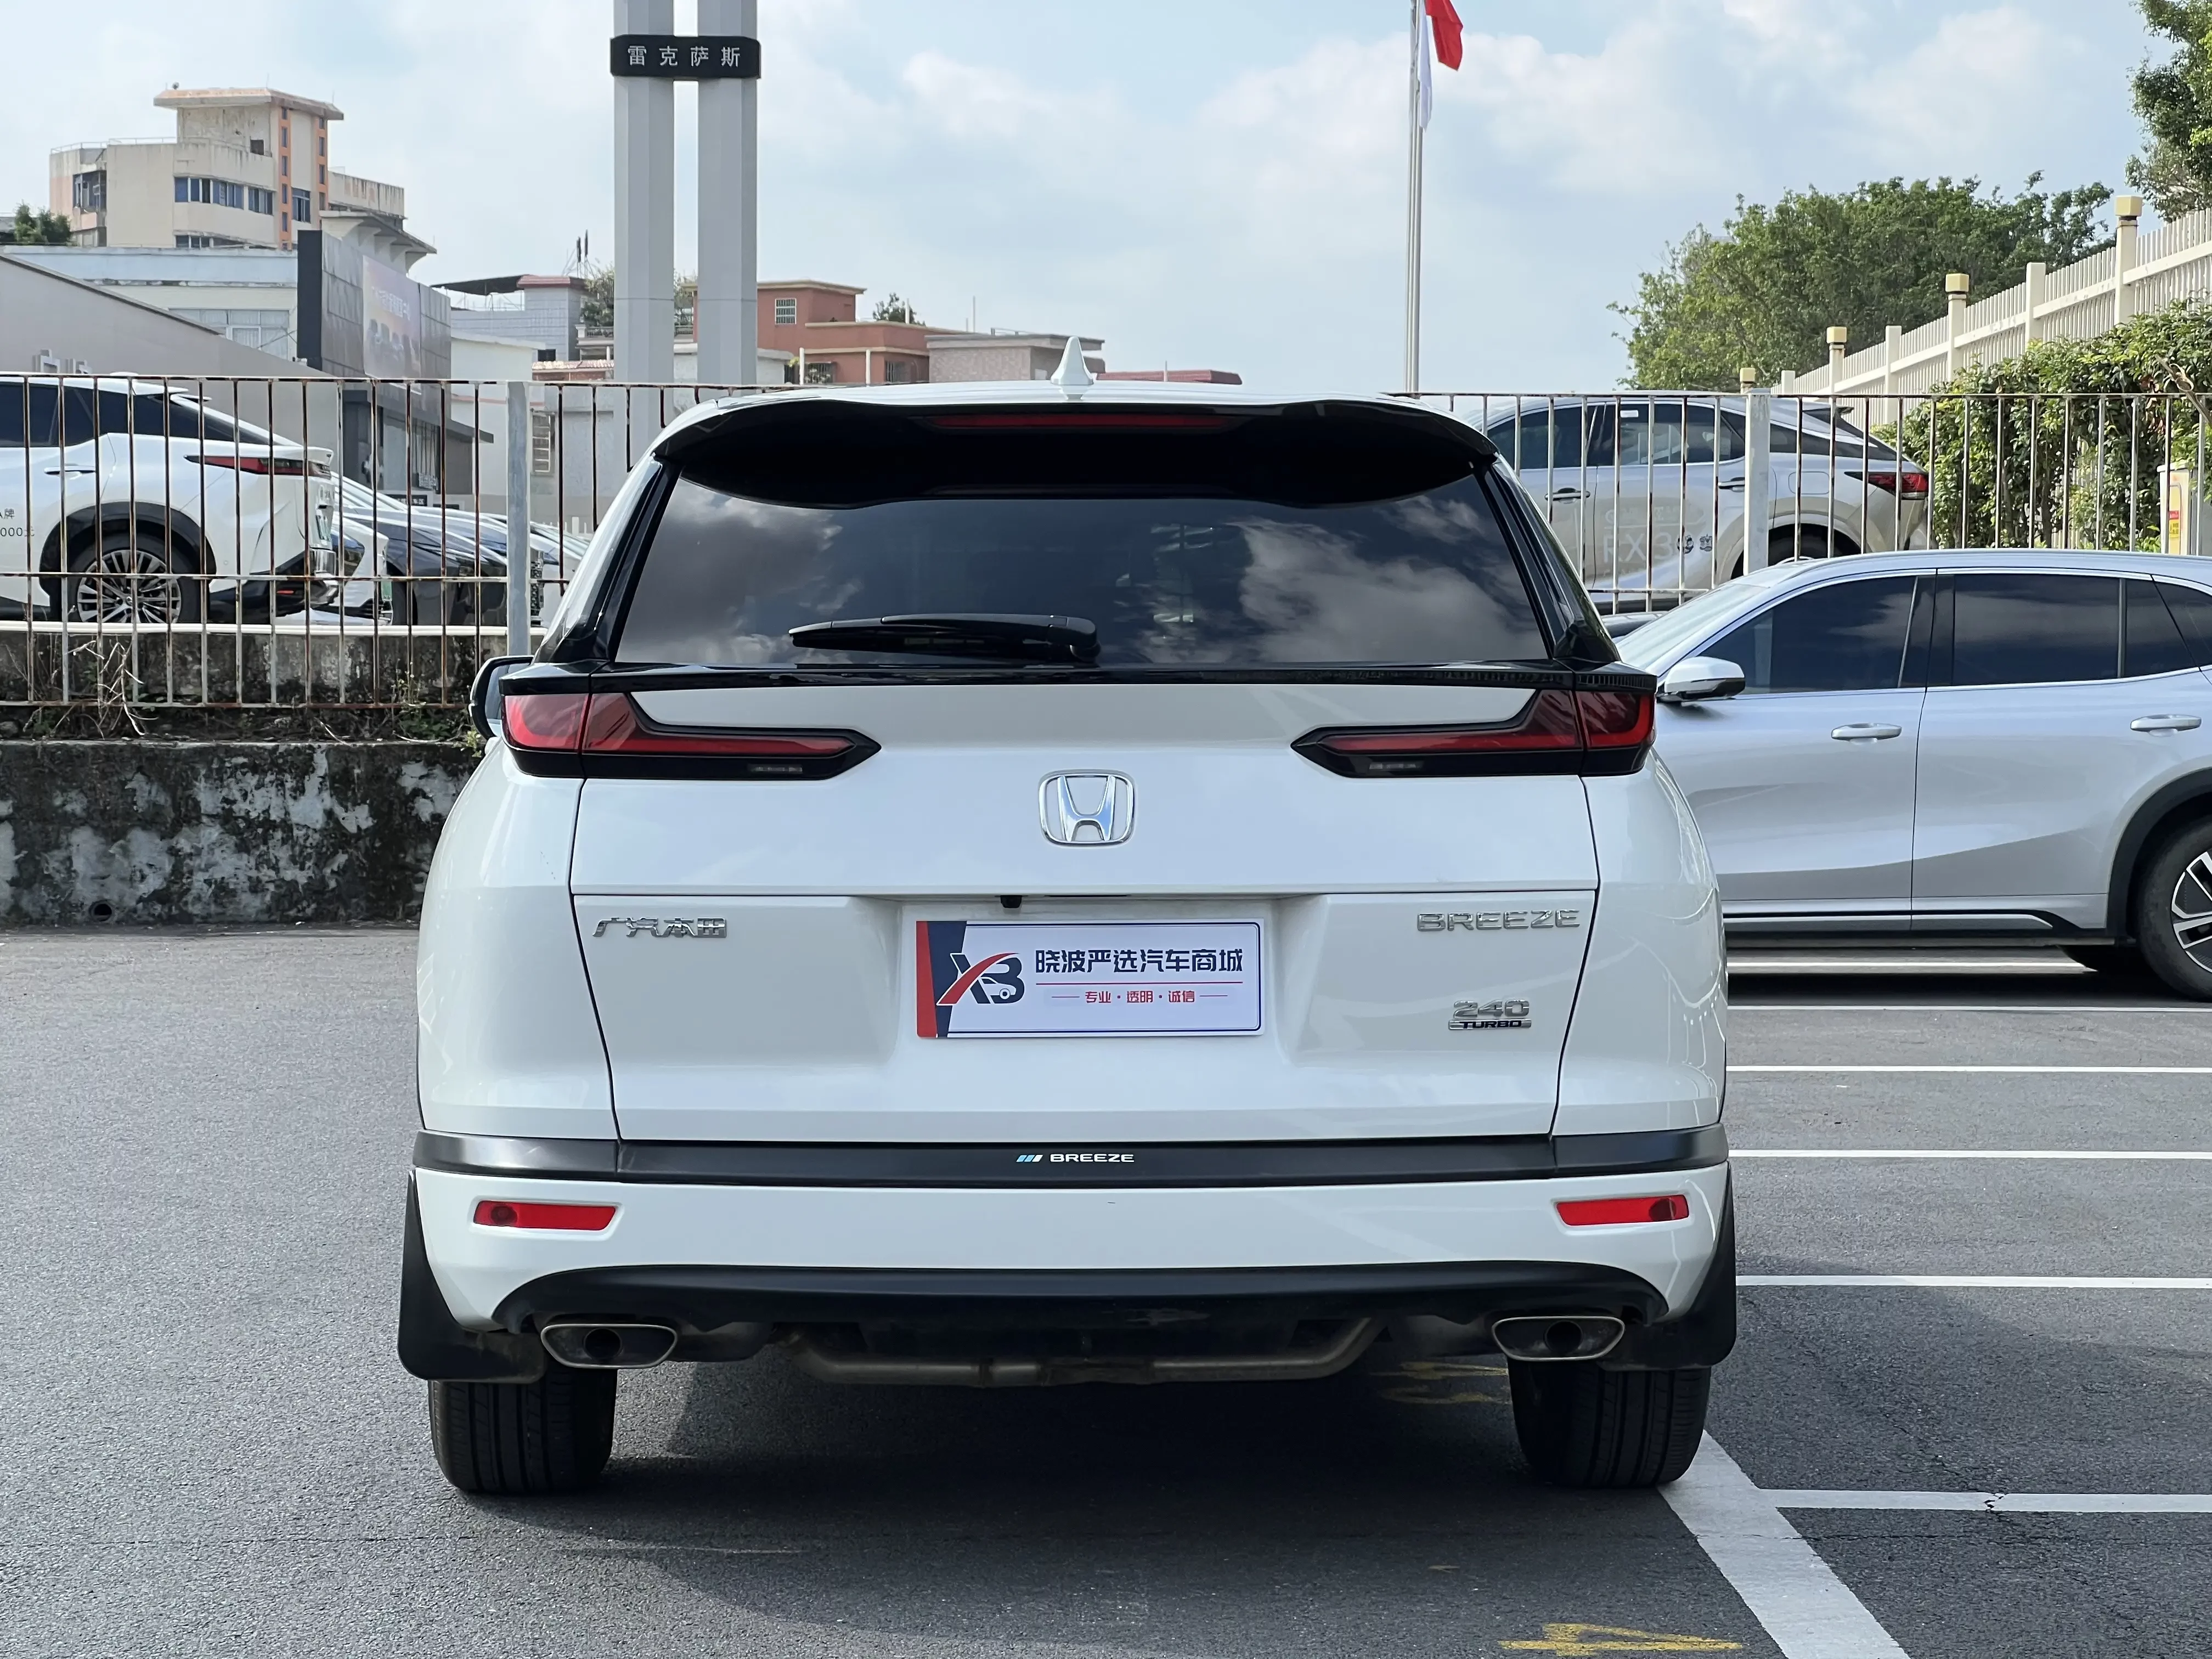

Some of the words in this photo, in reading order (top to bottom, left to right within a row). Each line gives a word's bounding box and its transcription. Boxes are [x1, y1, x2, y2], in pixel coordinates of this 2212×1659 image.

[627, 45, 741, 67] 雷克萨斯
[592, 917, 727, 938] 广汽本田
[1417, 909, 1581, 932] BREEZE
[1035, 949, 1243, 973] 晓波严选汽车商城
[1453, 999, 1530, 1018] 240
[1459, 1020, 1522, 1029] TURBO
[1050, 1153, 1135, 1163] BREEZE
